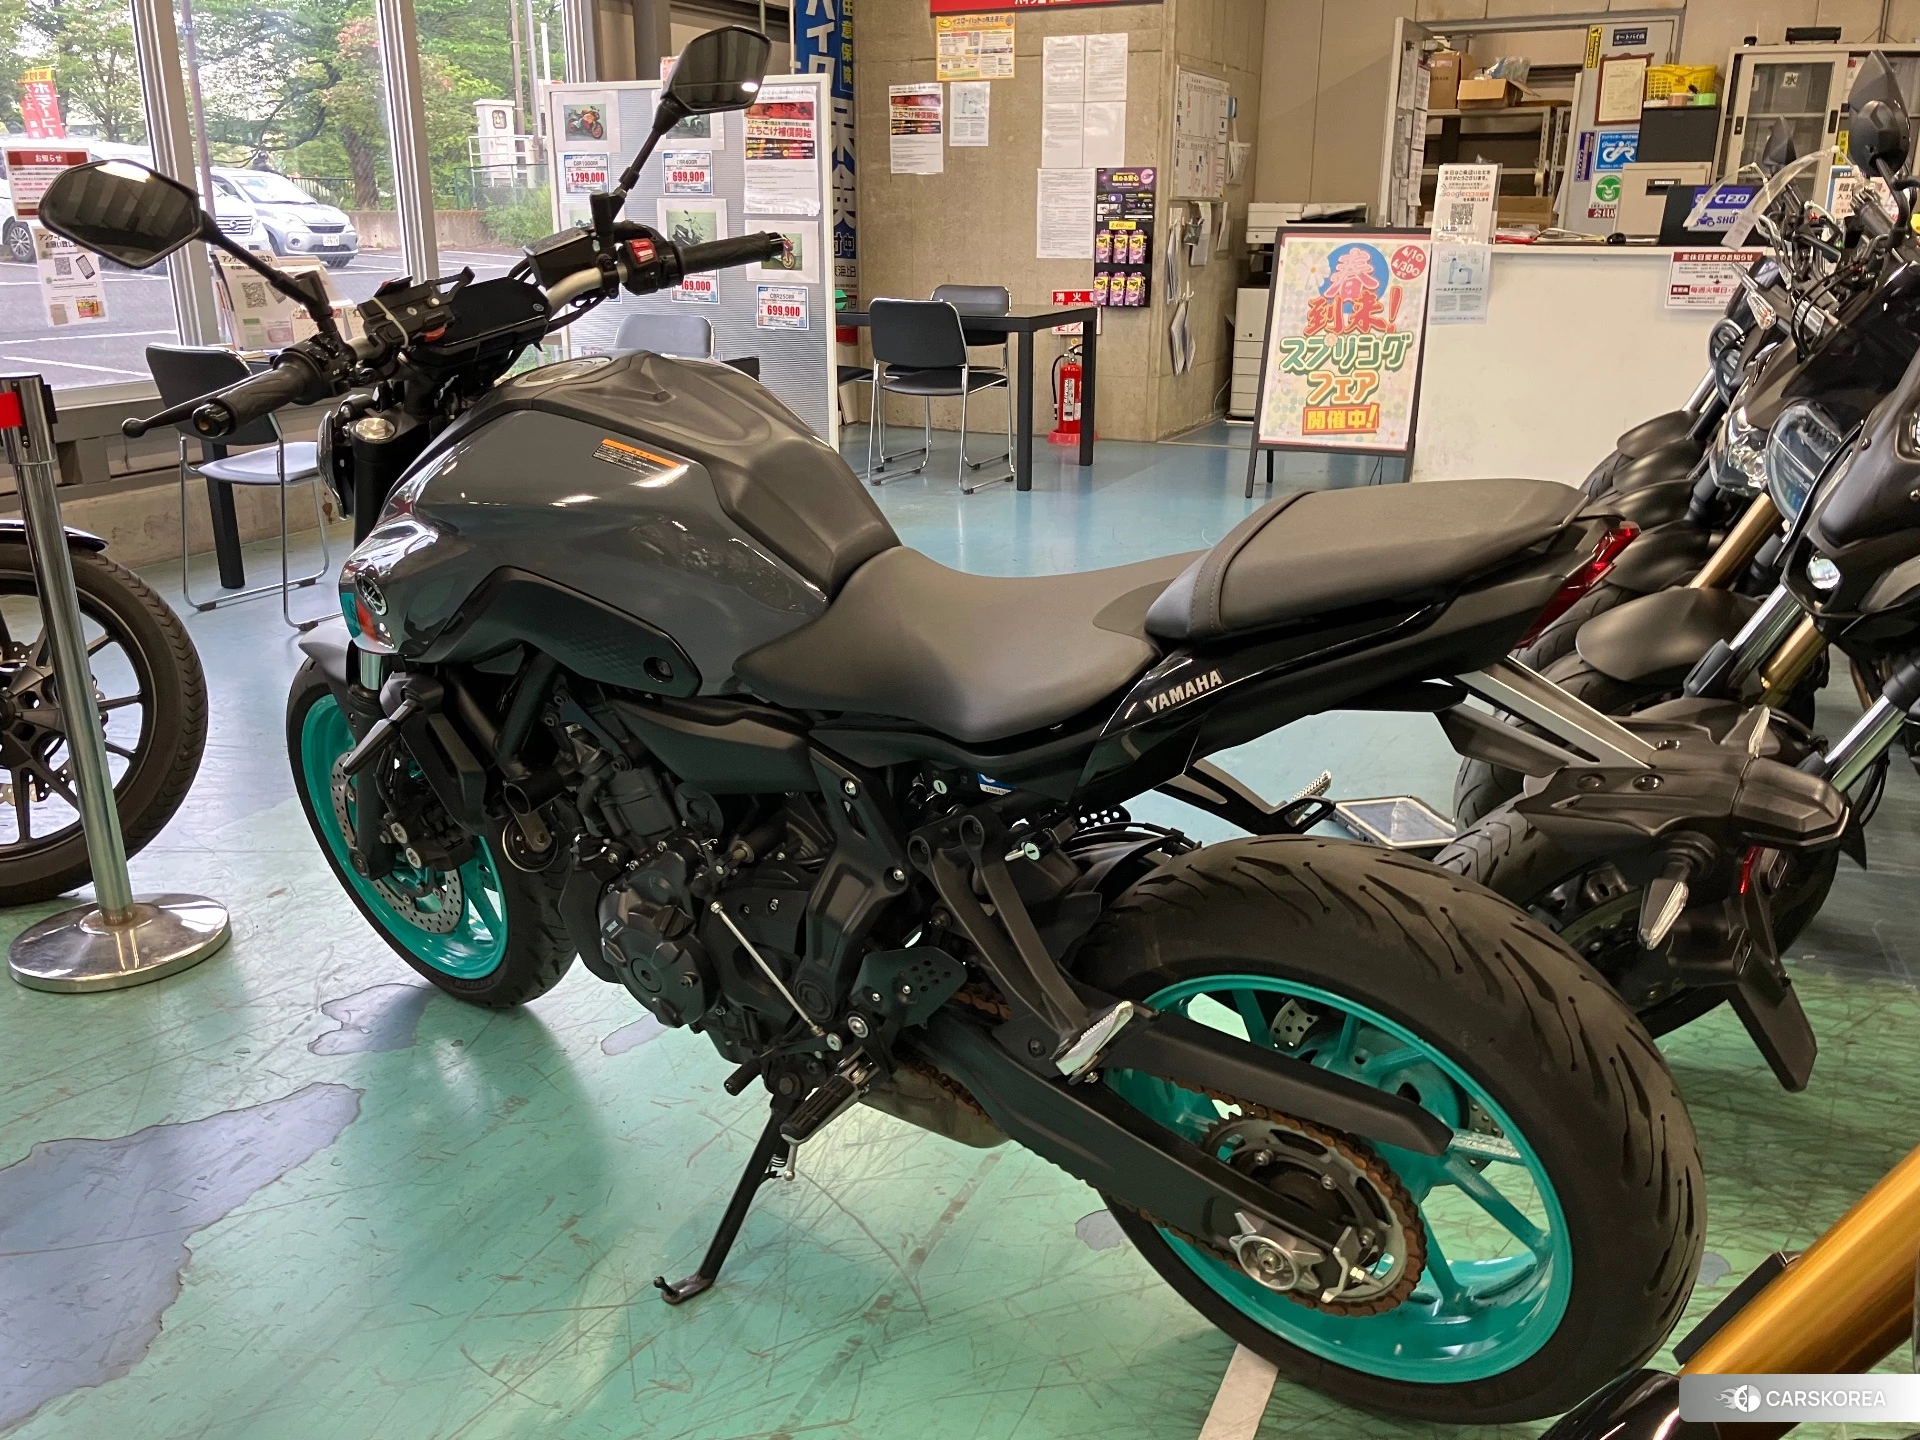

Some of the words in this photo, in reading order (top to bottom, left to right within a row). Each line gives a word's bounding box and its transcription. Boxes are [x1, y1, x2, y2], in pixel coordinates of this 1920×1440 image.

[747, 126, 812, 138] 立ちごけ補償開始
[35, 154, 63, 163] お知らせ
[570, 172, 605, 183] 1,299,000
[672, 171, 705, 183] 699,900
[1716, 215, 1738, 224] SHO
[1682, 253, 1753, 261] 定休日変更のお知らせ
[1323, 247, 1379, 302] 春
[1055, 292, 1094, 302] 消火
[767, 304, 800, 317] 699,900
[1303, 286, 1403, 336] 到来!
[1279, 332, 1414, 375] スプリング
[1306, 370, 1379, 405] フェア
[1307, 405, 1378, 430] 開催中!
[1146, 670, 1223, 713] YAMAHA
